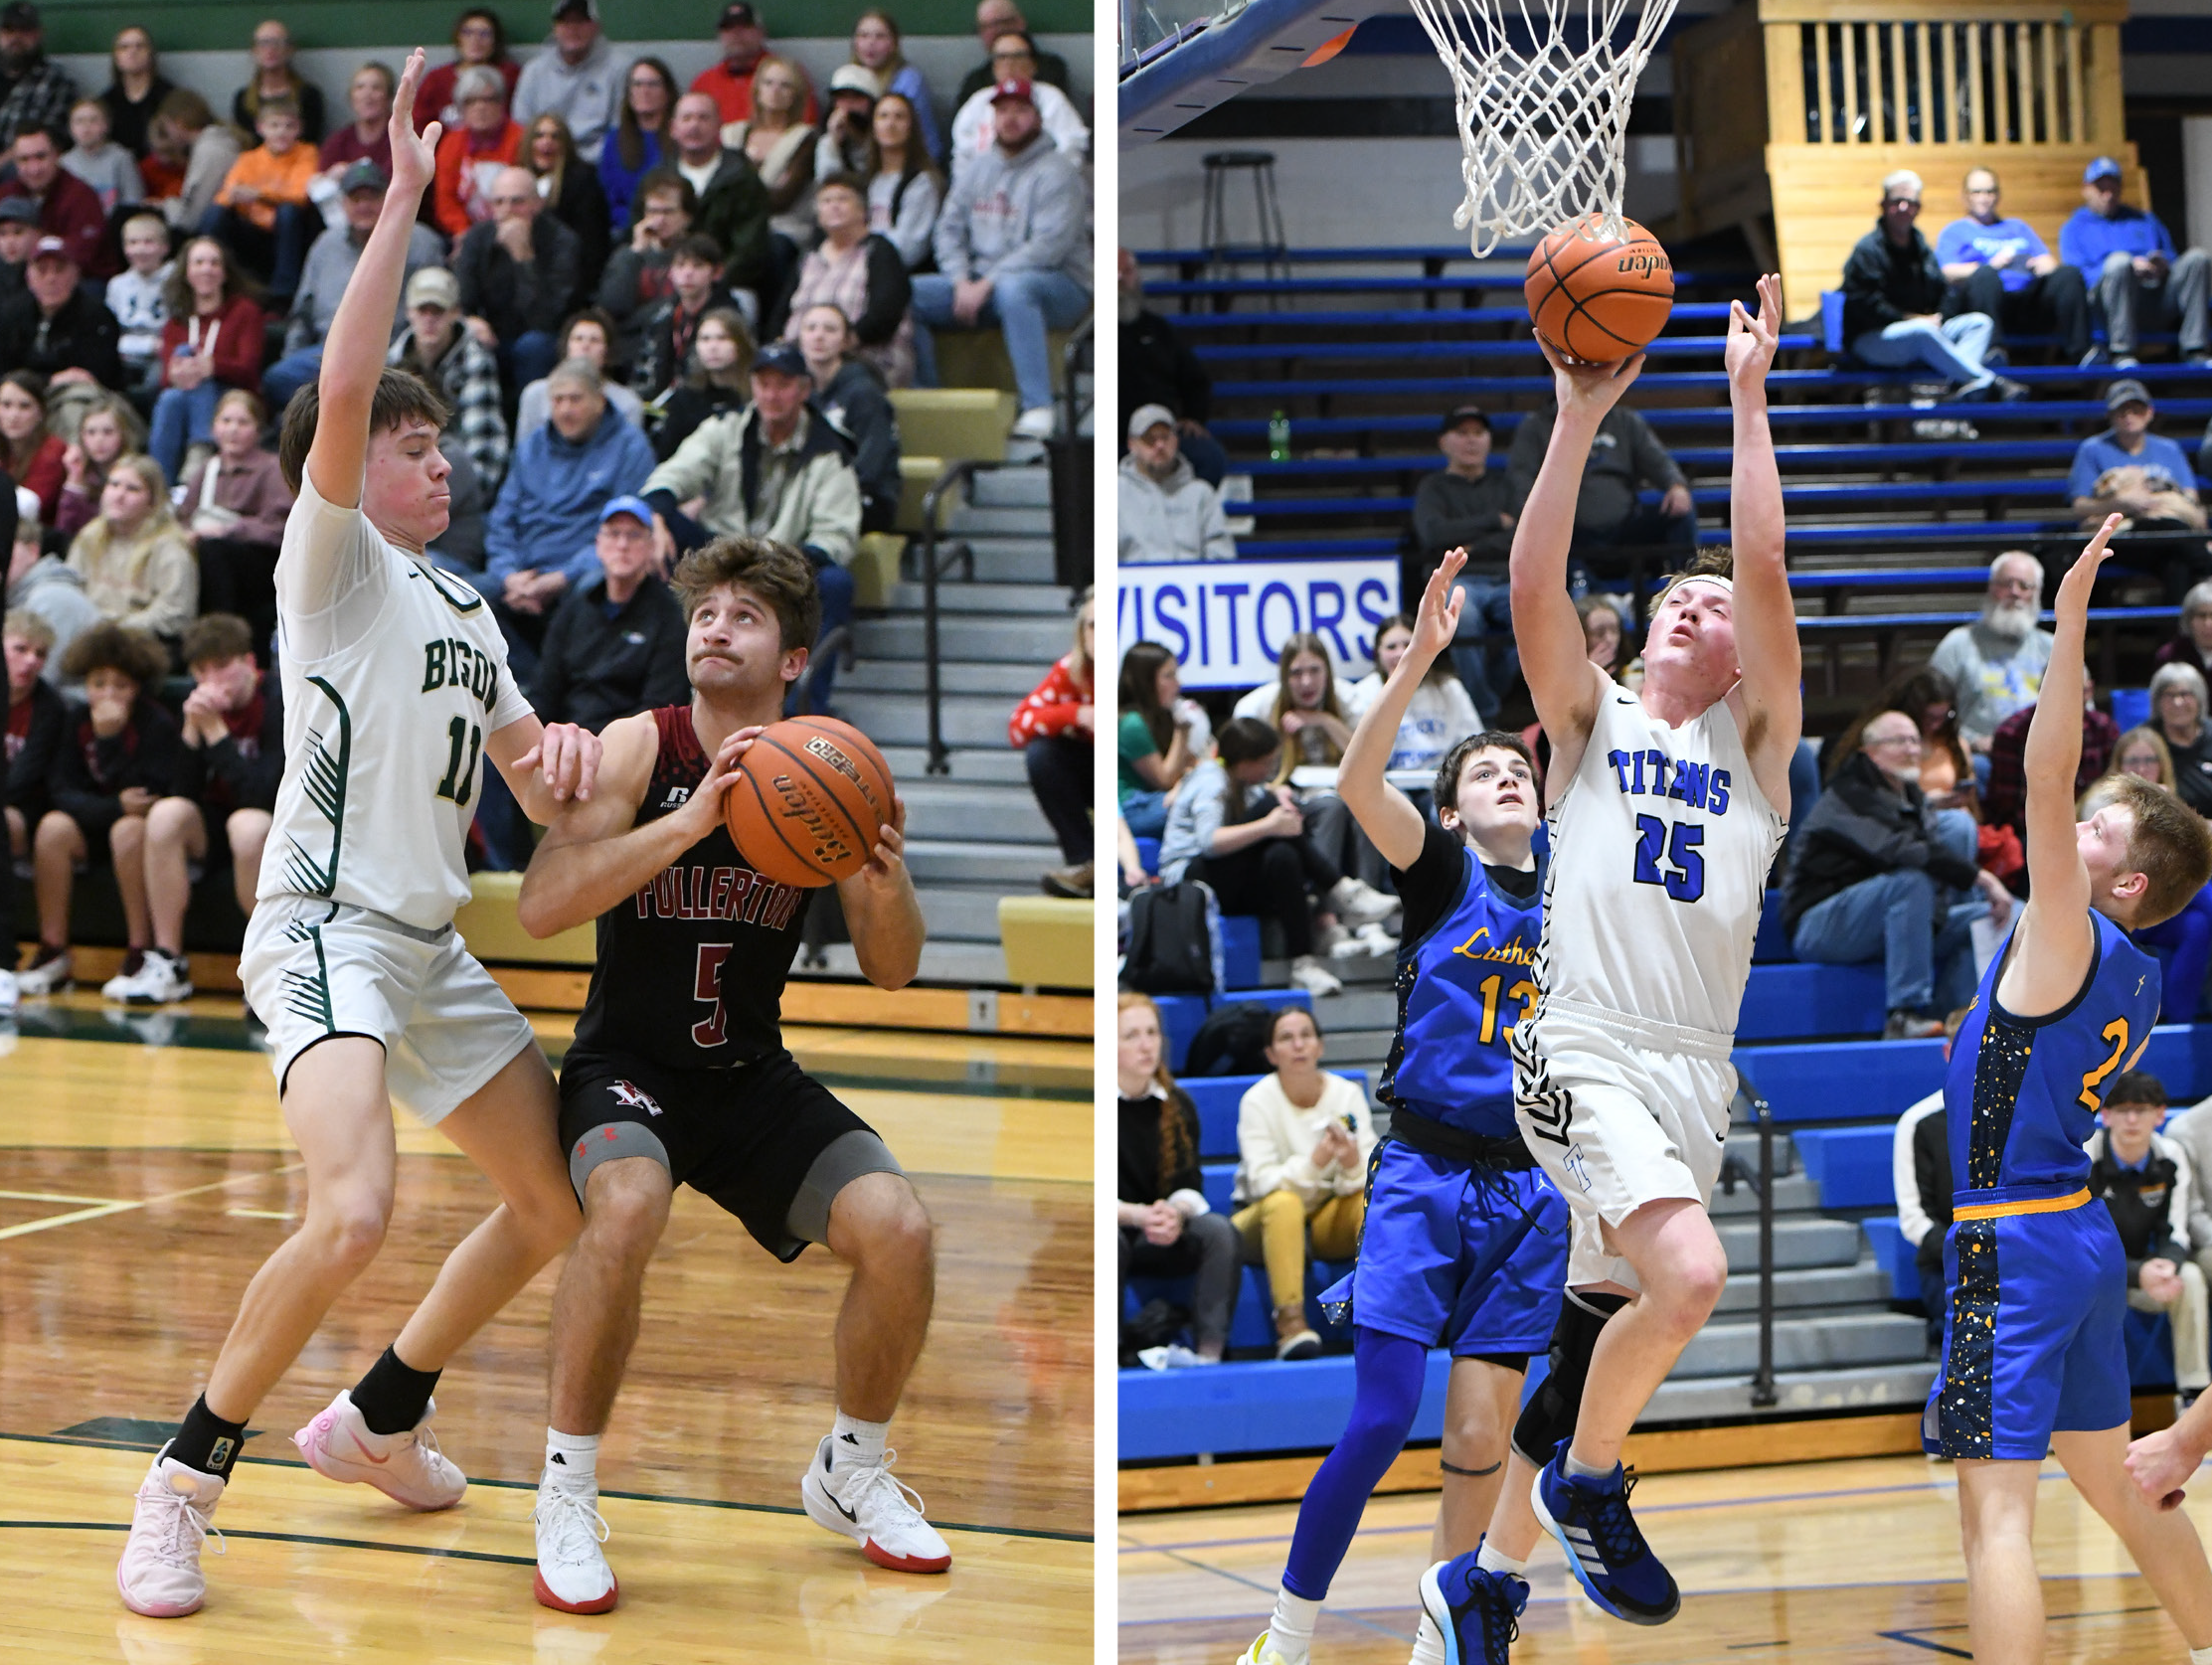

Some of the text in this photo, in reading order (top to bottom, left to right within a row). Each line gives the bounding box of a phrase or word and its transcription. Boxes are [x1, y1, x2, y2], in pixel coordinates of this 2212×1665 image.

[1617, 254, 1674, 282] aden
[434, 713, 482, 809] 11
[1608, 749, 1731, 816] TITANS
[771, 774, 853, 864] Baden
[1633, 812, 1705, 903] 25
[636, 866, 803, 930] FULLERTON
[1452, 926, 1536, 966] Luthe
[692, 942, 734, 1048] 5
[1478, 974, 1540, 1047] 13
[2075, 1015, 2129, 1114] 2
[1563, 1143, 1592, 1193] T
